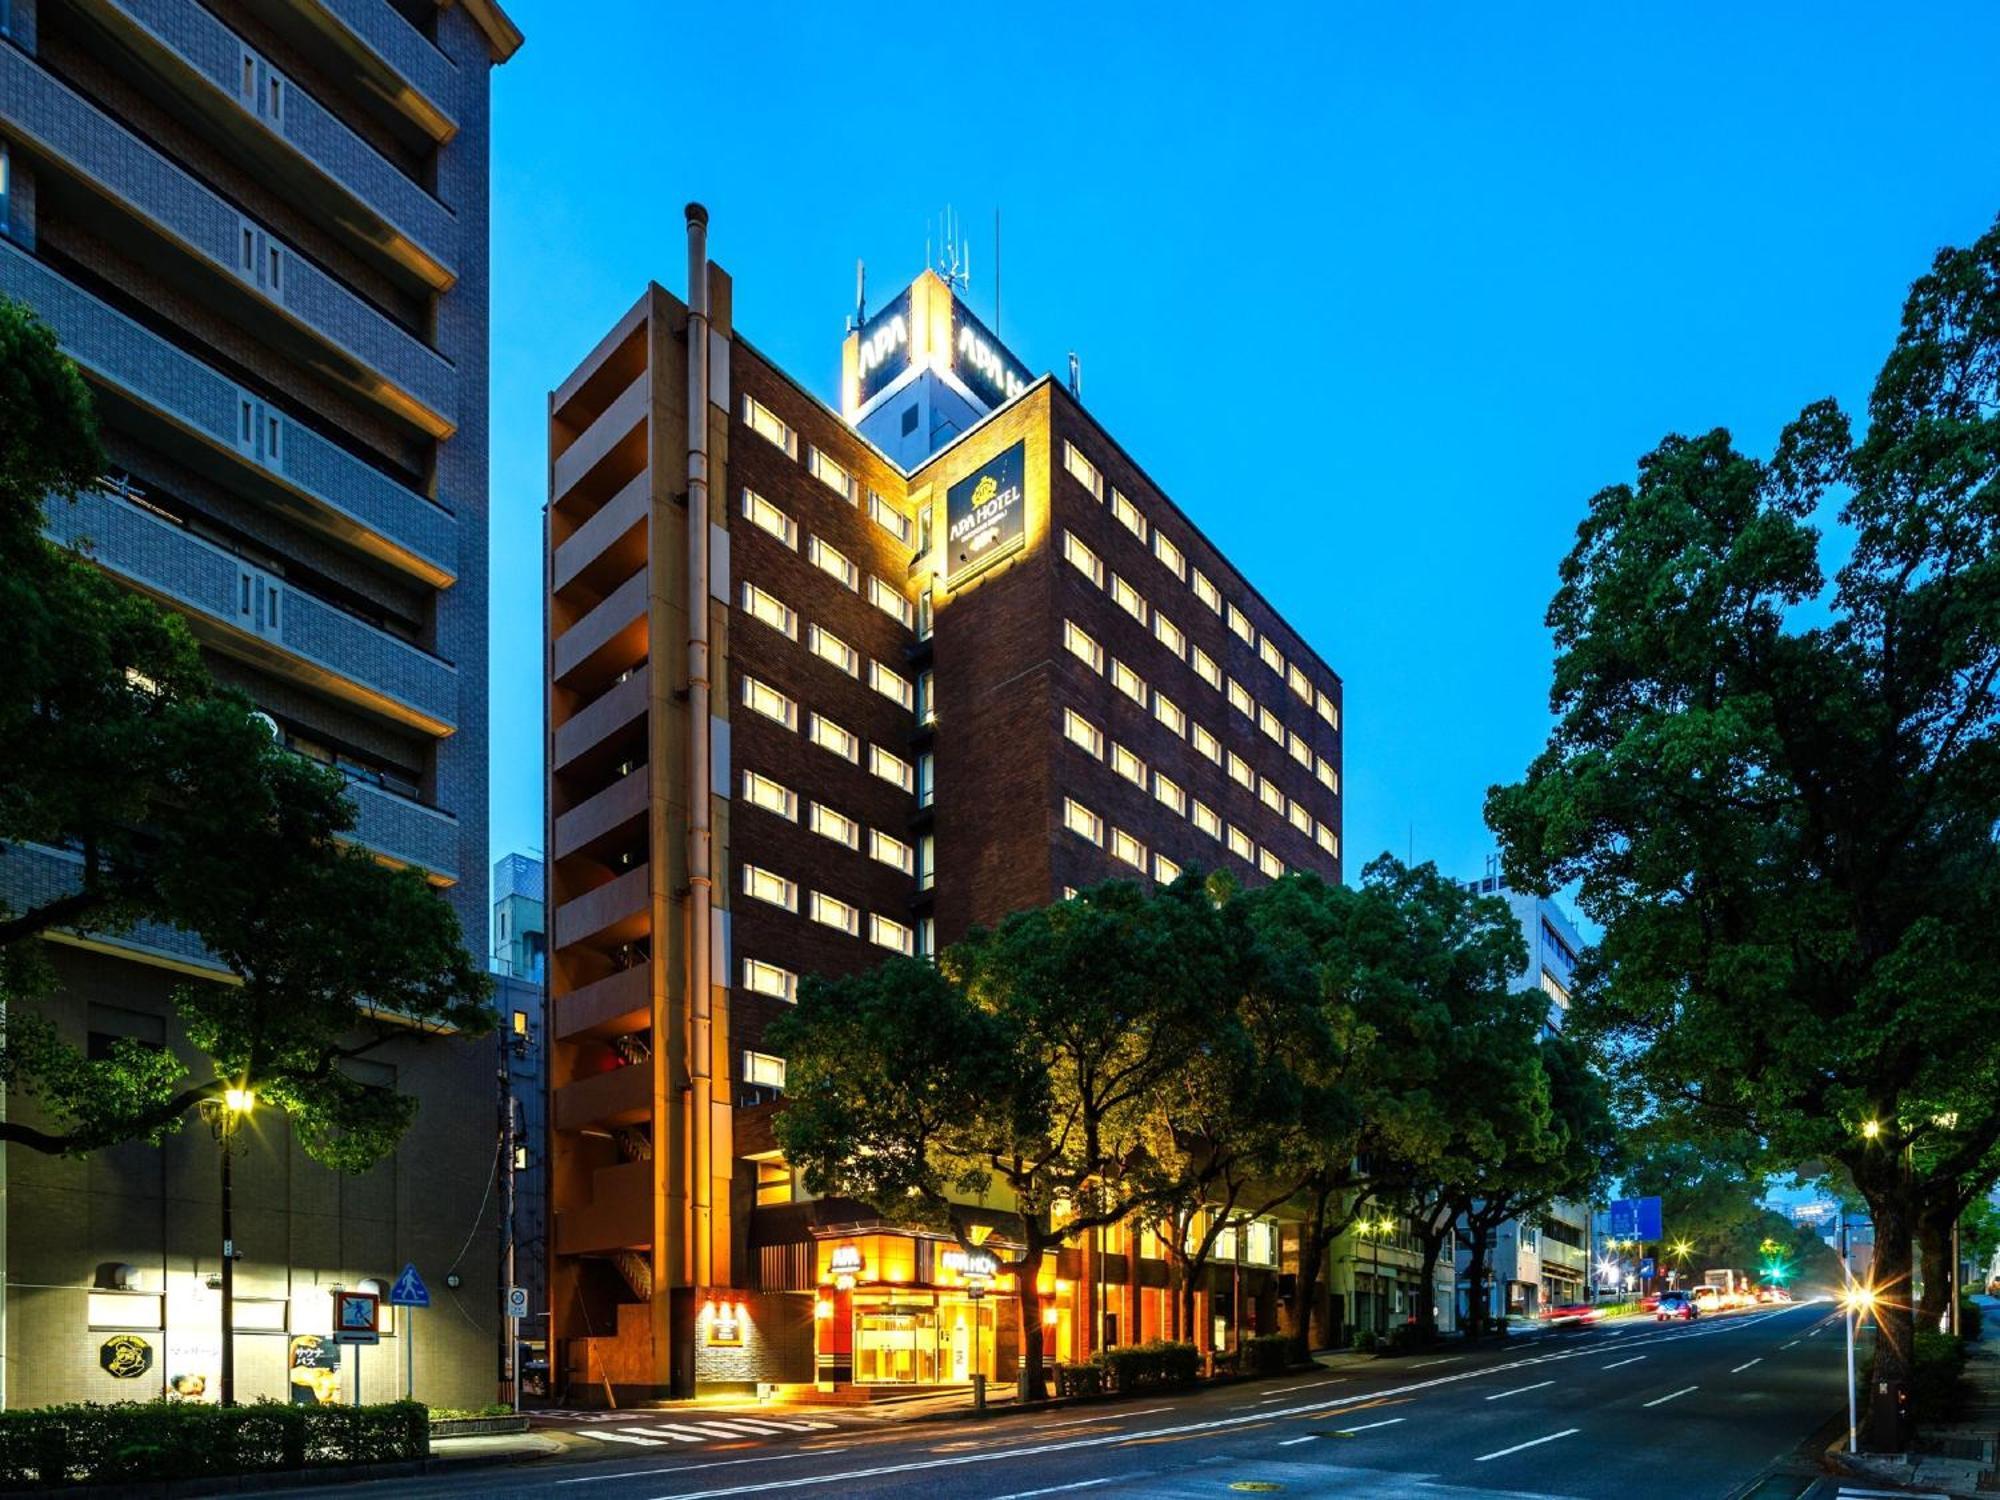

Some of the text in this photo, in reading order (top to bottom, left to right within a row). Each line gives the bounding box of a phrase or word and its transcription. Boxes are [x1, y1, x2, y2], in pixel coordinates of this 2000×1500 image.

[859, 316, 907, 379] APA
[959, 327, 1004, 390] APA
[950, 514, 975, 541] APA
[976, 486, 1021, 524] HOTEL
[295, 1347, 324, 1358] サウナ
